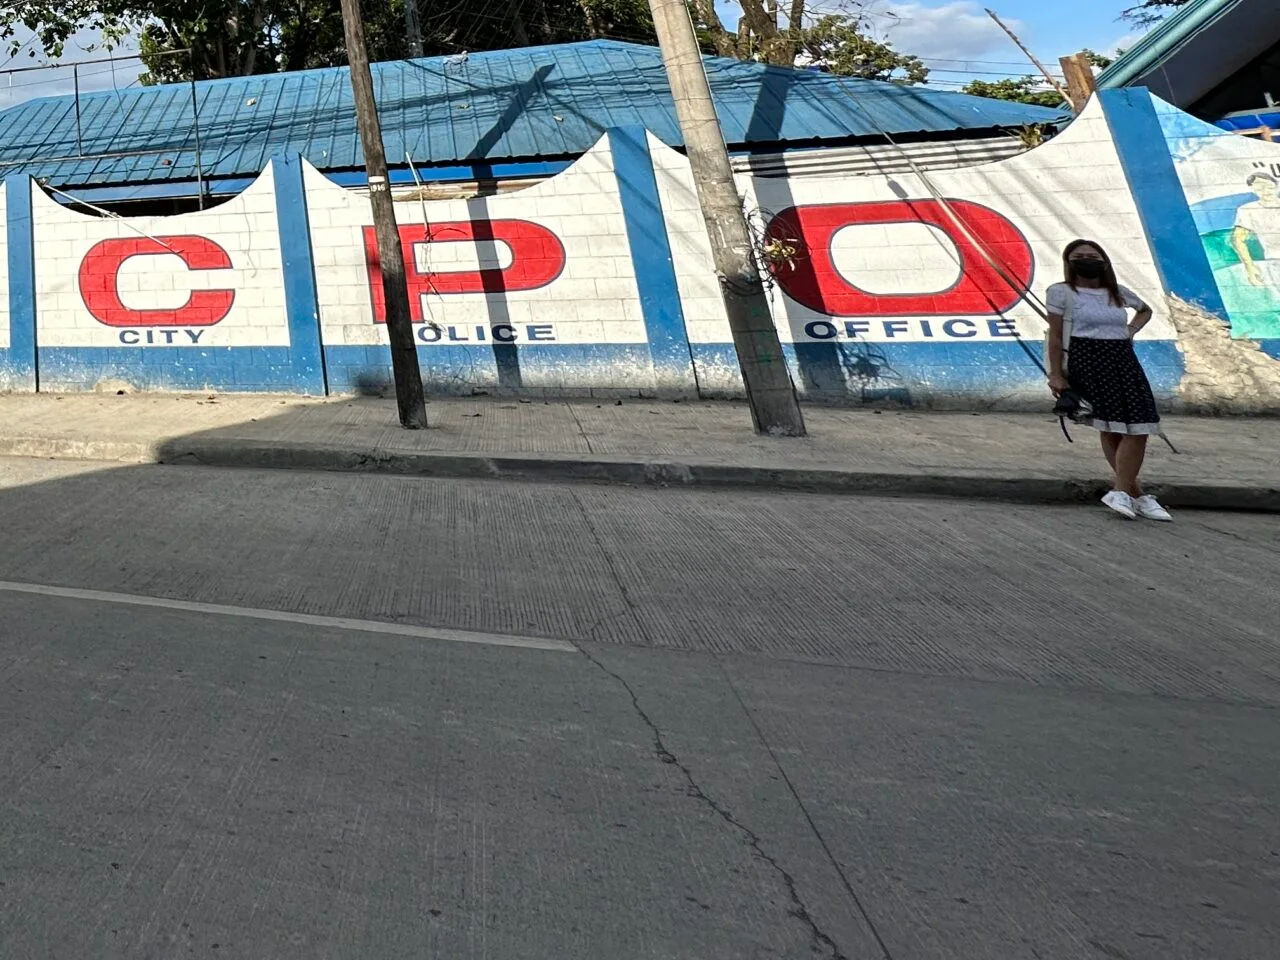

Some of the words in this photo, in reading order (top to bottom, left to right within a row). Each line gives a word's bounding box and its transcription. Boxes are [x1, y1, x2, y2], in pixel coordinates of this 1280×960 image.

[118, 329, 206, 345] CITY
[416, 324, 557, 343] OLICE
[804, 318, 1022, 340] OFFICE
